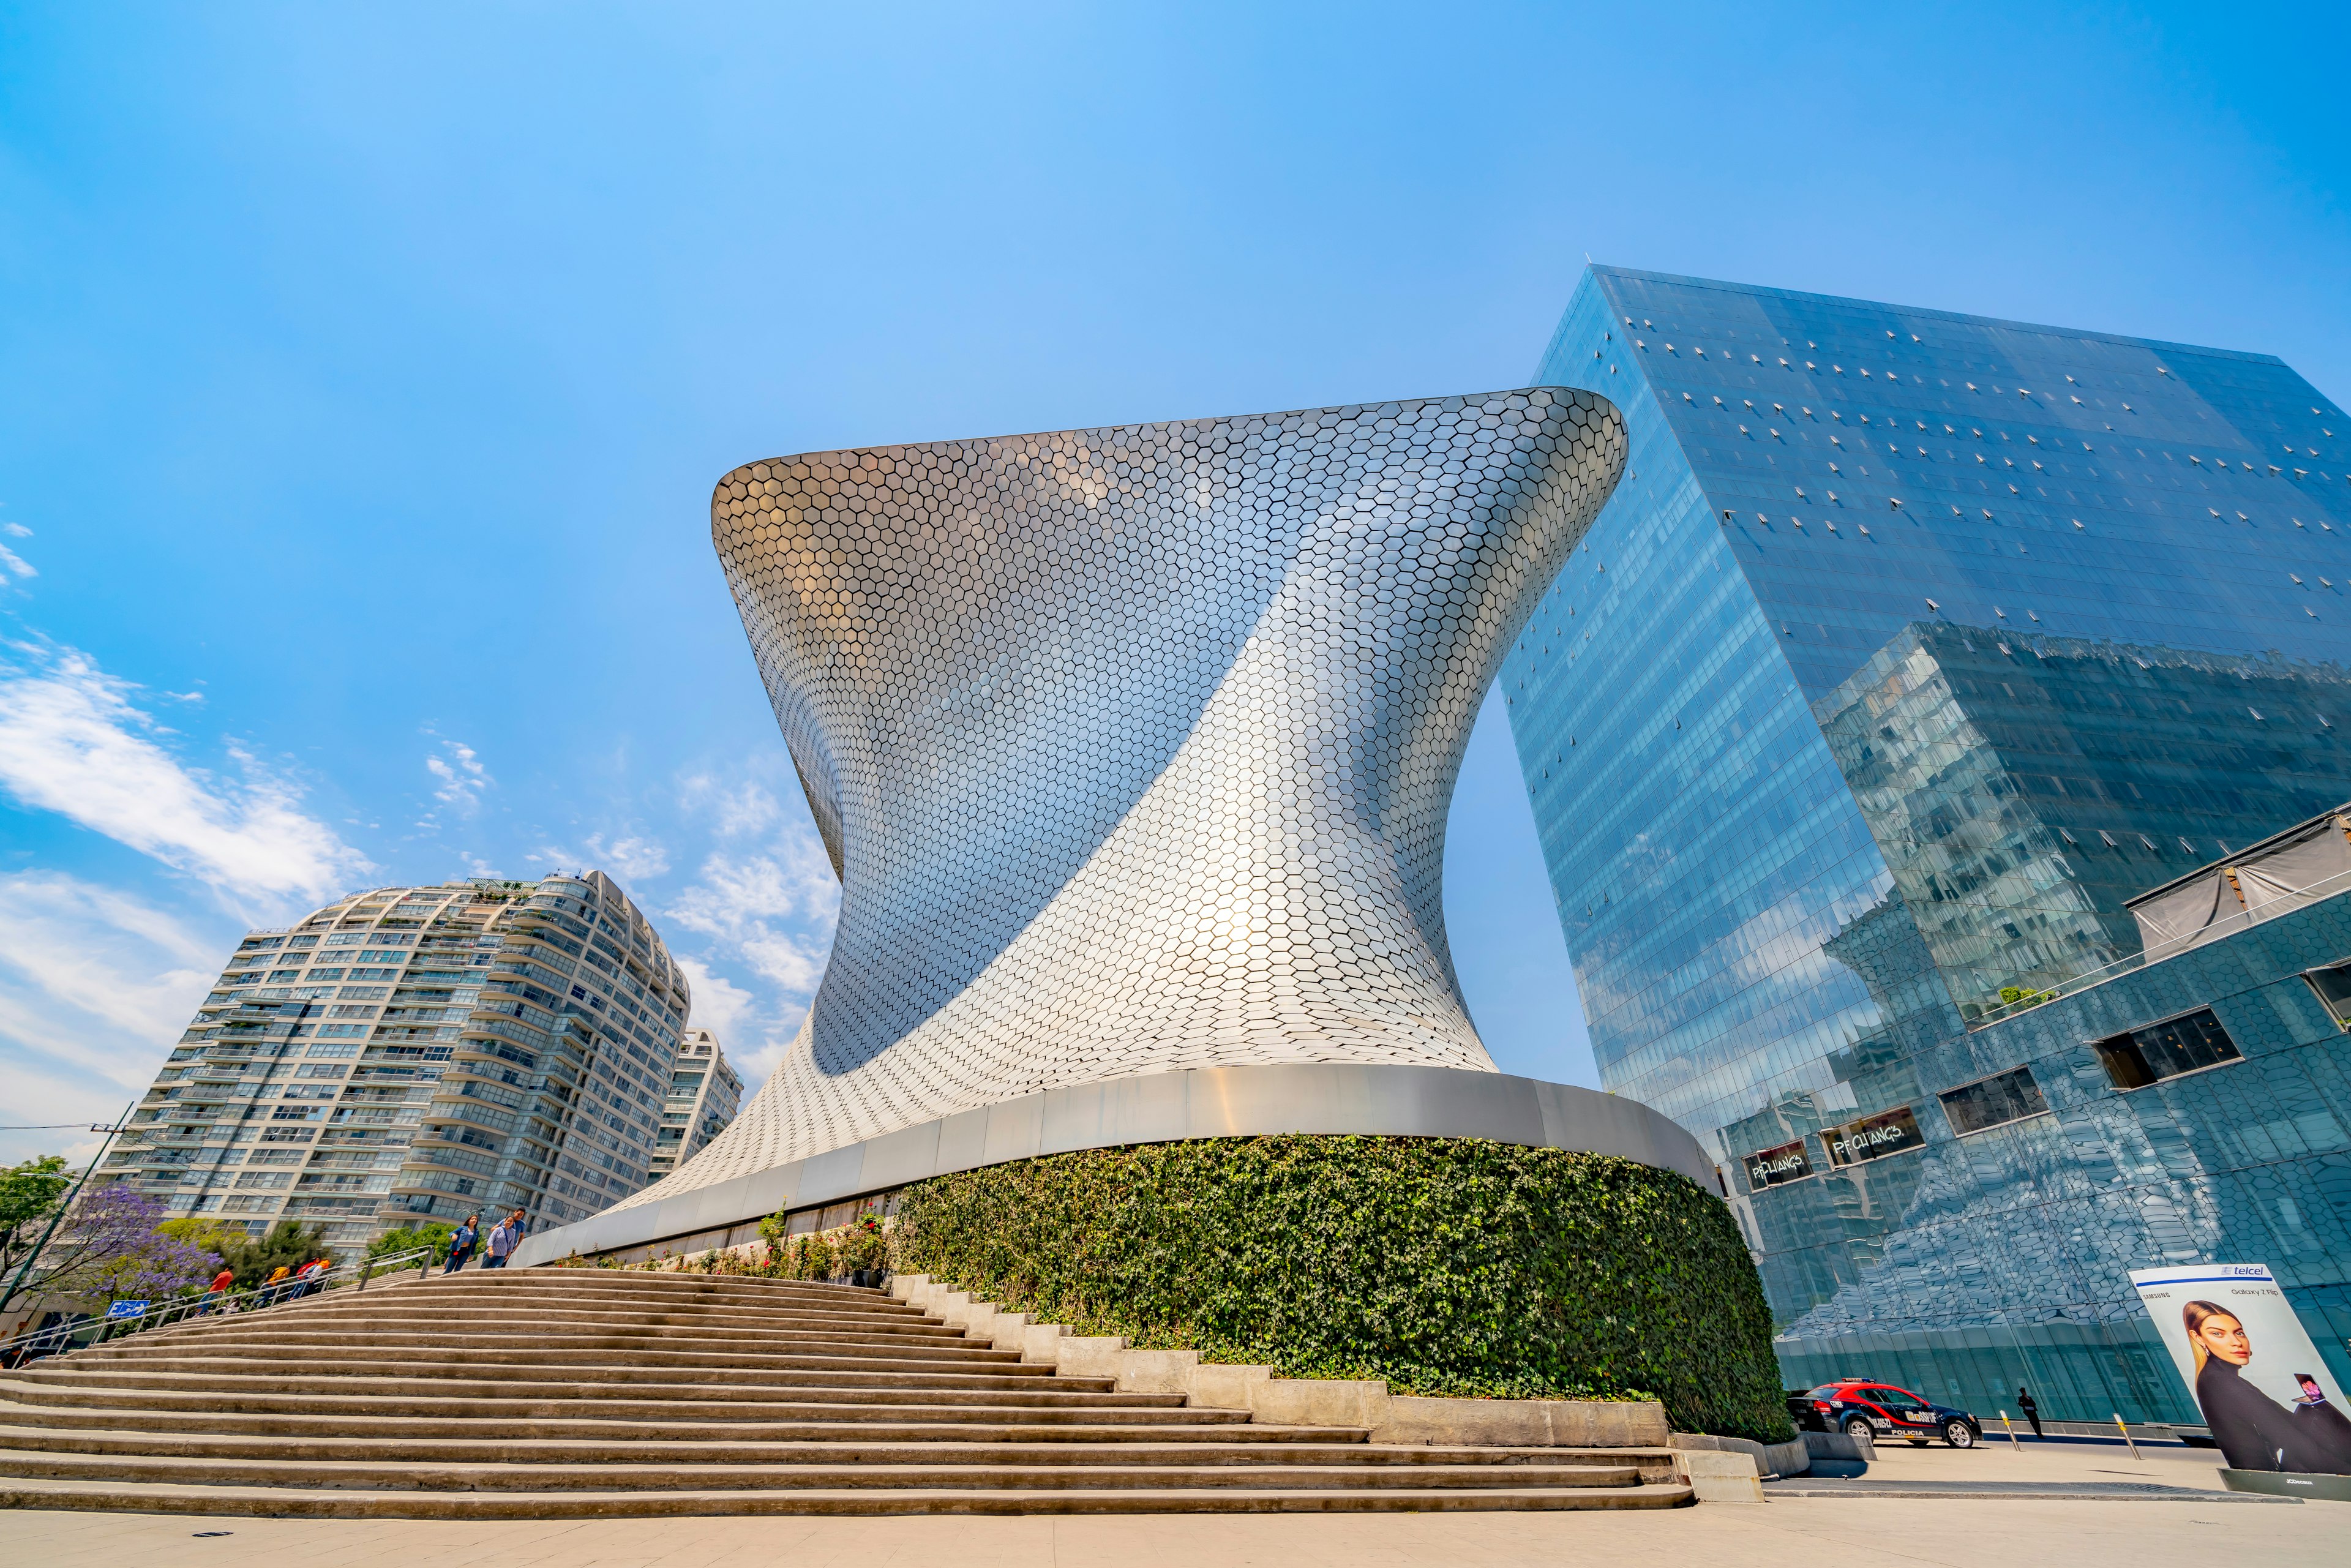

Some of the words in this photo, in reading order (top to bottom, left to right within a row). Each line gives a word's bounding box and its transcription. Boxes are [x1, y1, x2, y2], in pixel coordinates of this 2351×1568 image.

[1832, 1139, 1852, 1155] P.F.
[2234, 1266, 2263, 1275] telcel
[108, 1302, 122, 1316] E
